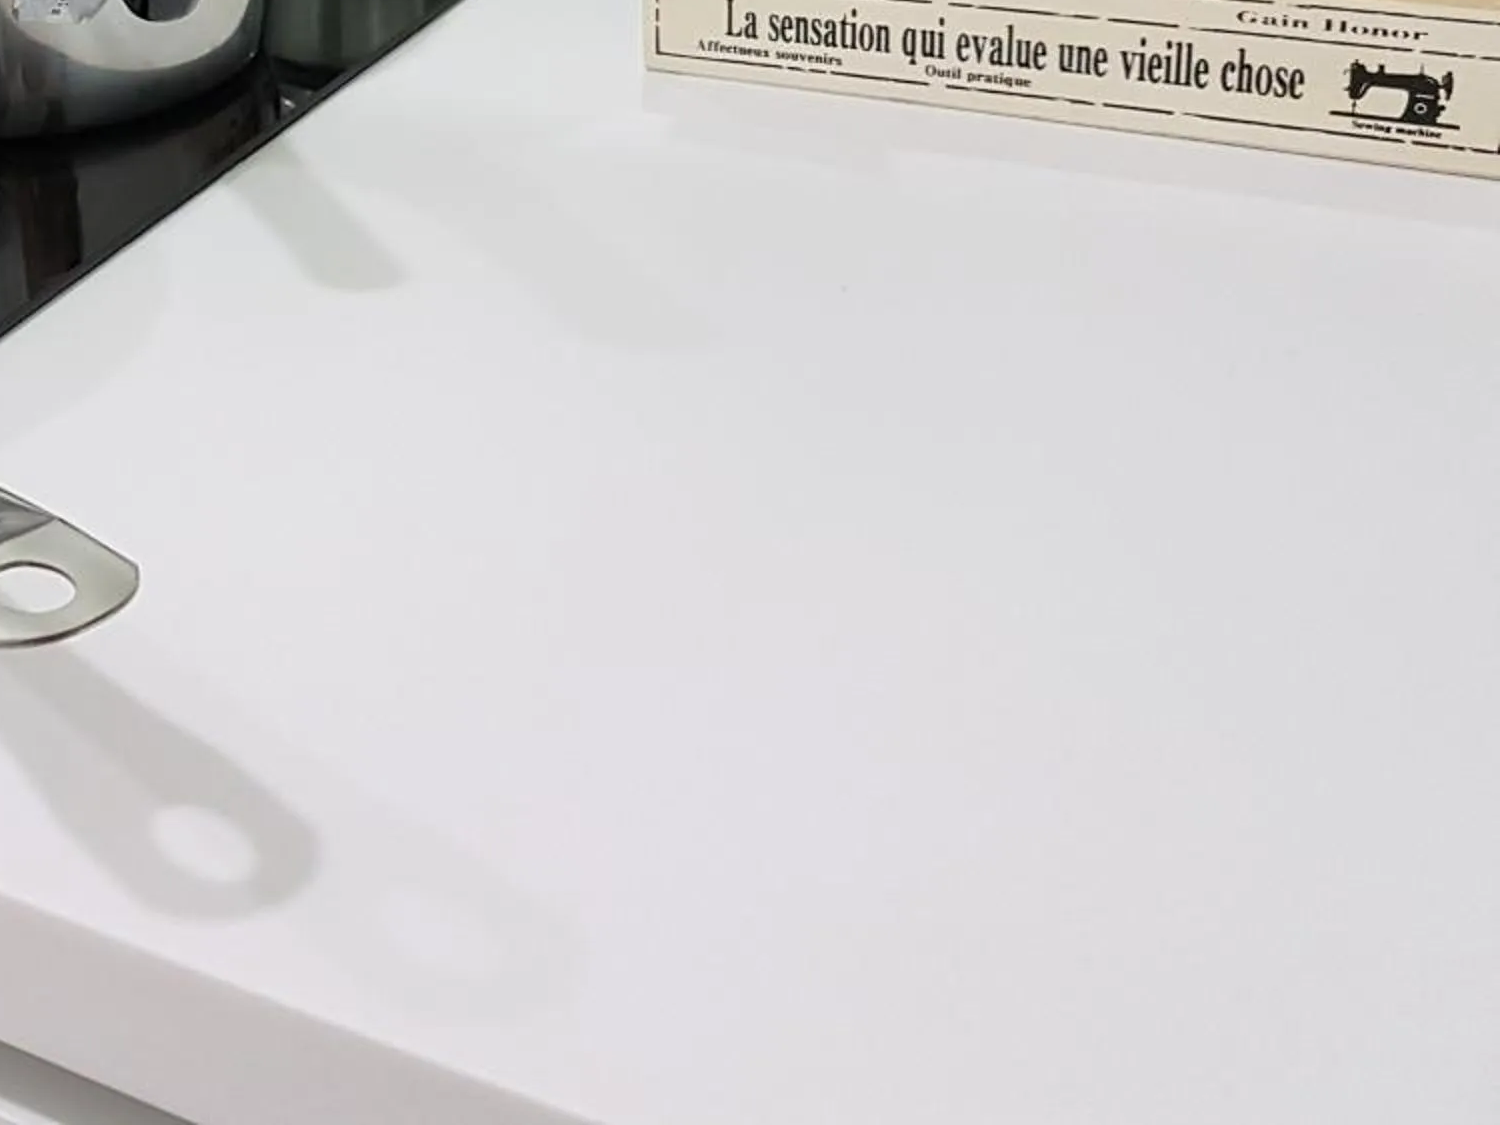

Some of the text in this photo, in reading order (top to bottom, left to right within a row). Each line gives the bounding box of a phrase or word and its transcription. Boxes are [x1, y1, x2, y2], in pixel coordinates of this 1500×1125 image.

[1236, 10, 1429, 41] Gain Honor
[768, 8, 891, 54] sensation
[902, 16, 946, 65] qui
[955, 24, 1047, 71] evalue
[1058, 43, 1108, 77] une
[1120, 37, 1209, 89] vieille
[1221, 48, 1305, 99] chose
[775, 50, 843, 66] souvenirs
[925, 64, 1032, 88] Outil pratique
